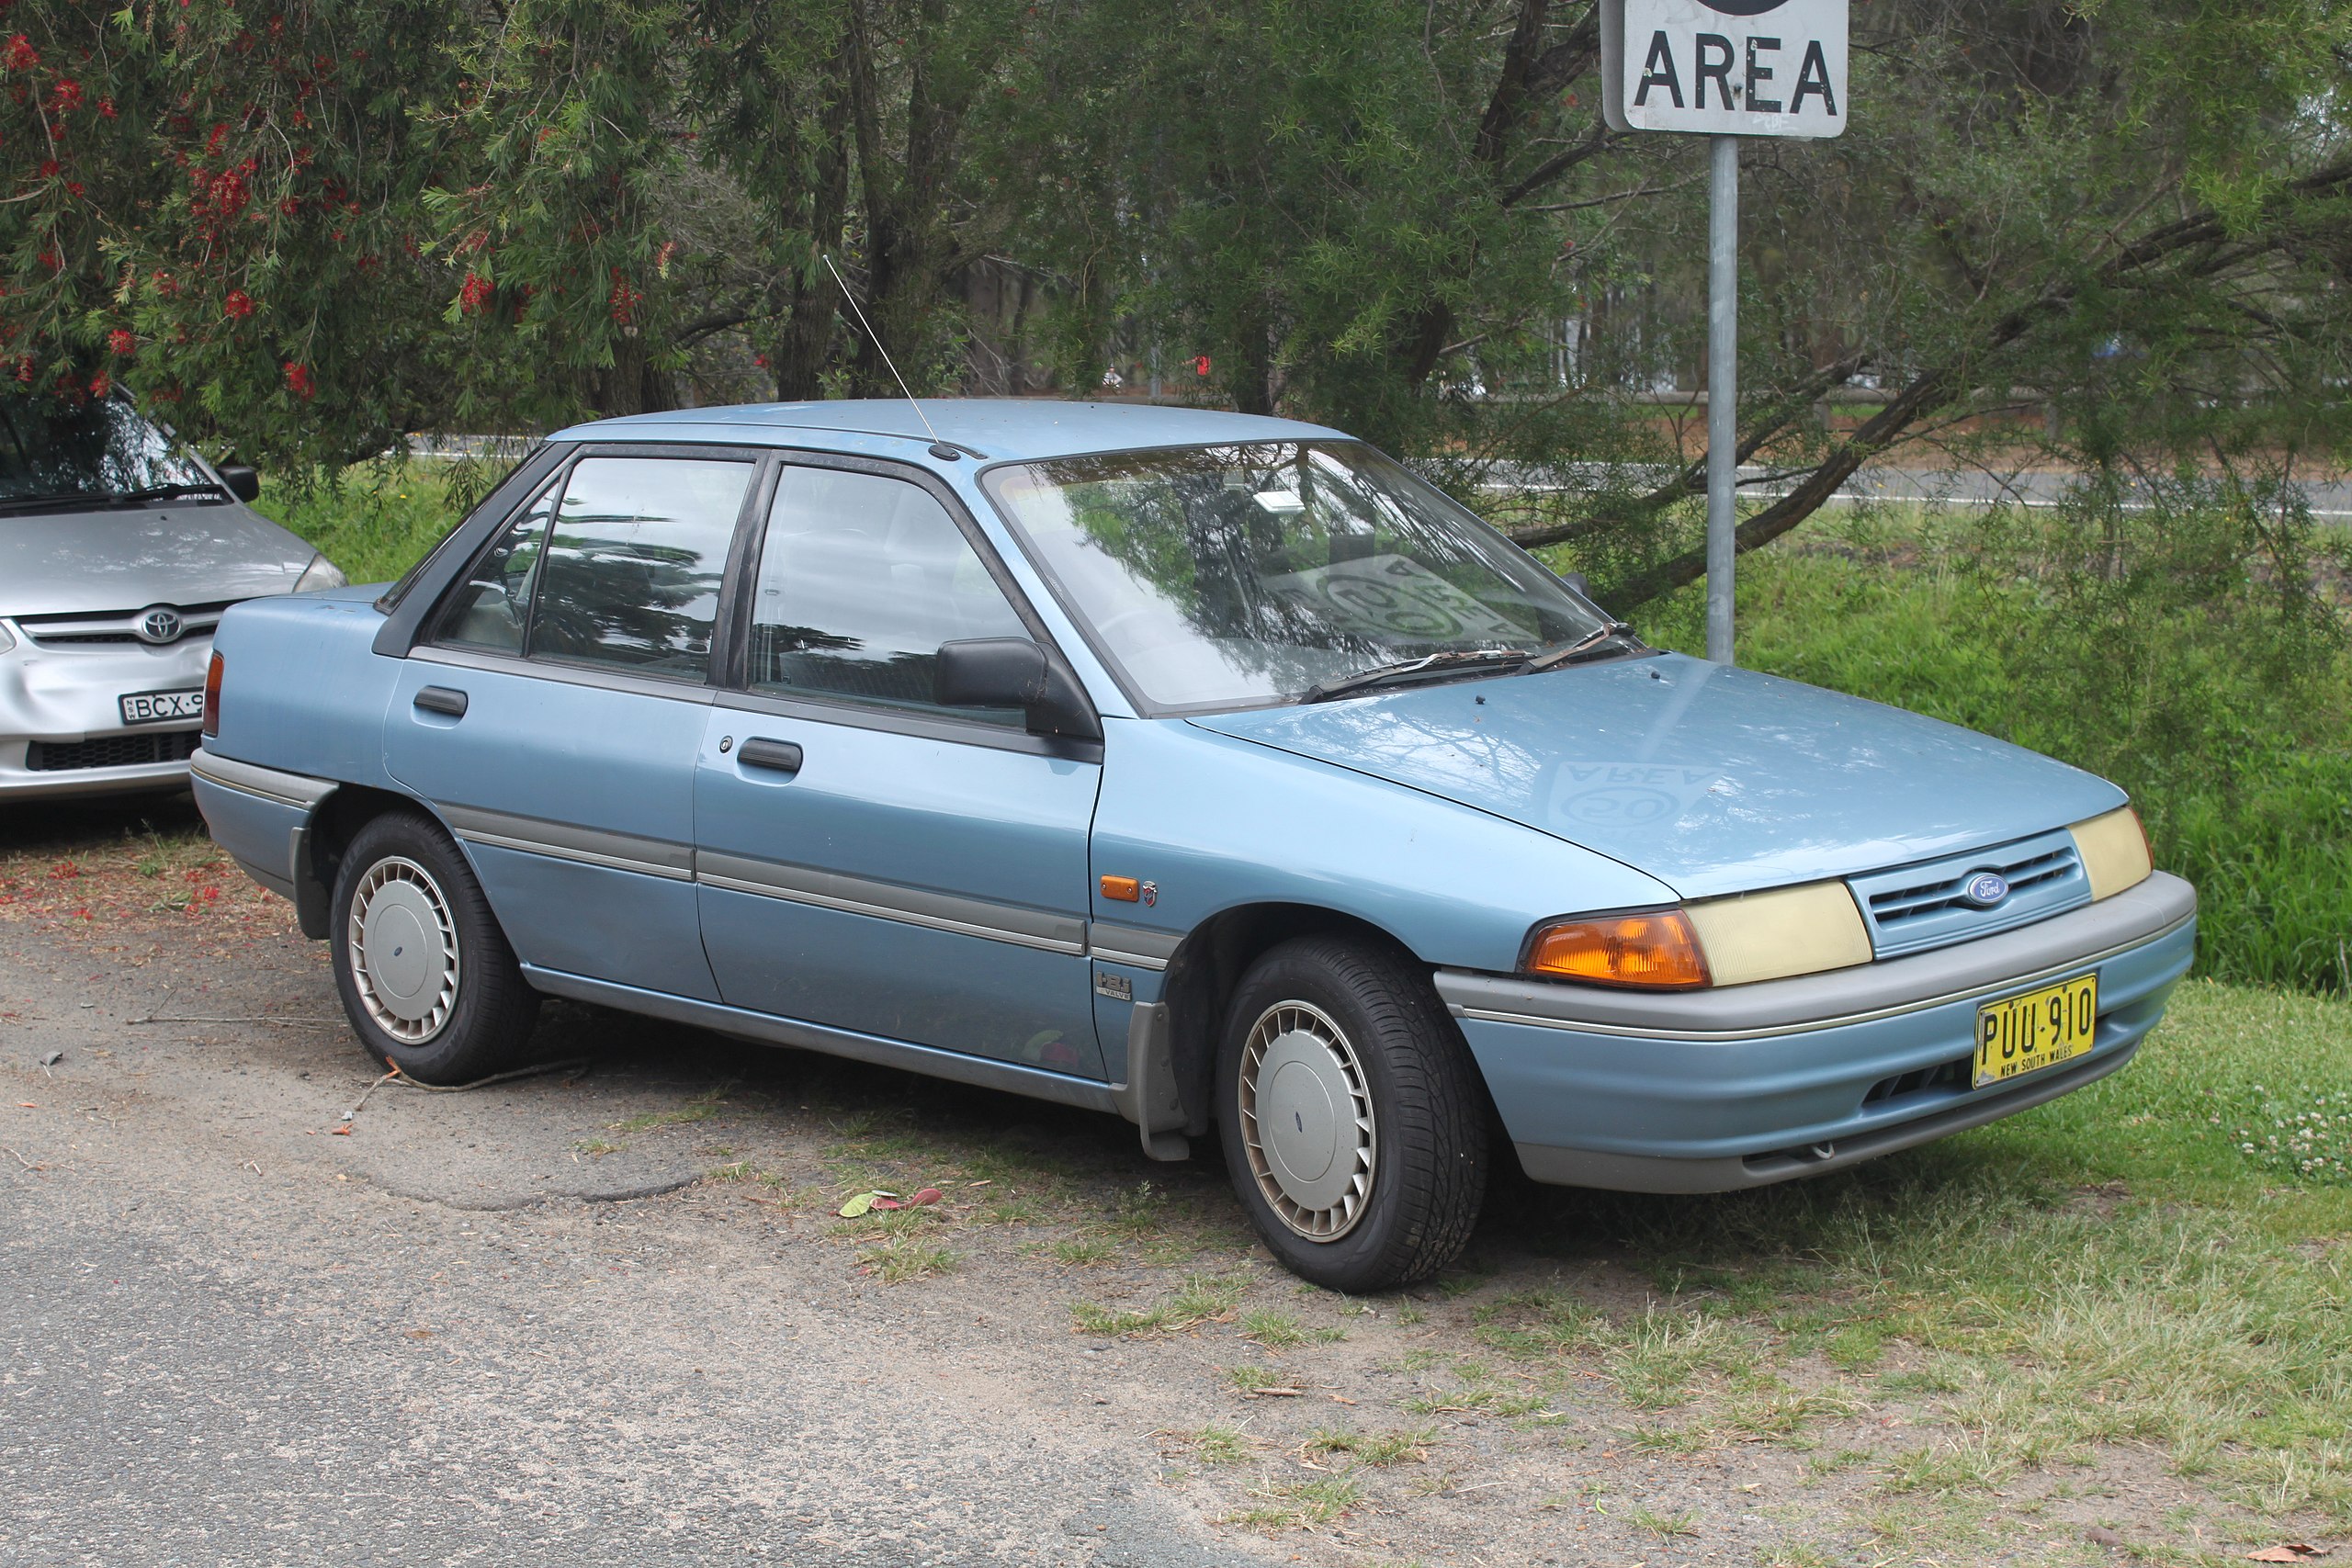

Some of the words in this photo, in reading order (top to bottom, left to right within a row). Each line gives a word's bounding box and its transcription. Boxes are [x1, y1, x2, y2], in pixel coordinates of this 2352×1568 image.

[1634, 30, 1838, 116] AREA
[126, 700, 136, 719] NSW
[1979, 880, 2000, 897] Ford
[2000, 1062, 2018, 1077] NEW
[2021, 1054, 2045, 1070] SOUTH
[2050, 1044, 2073, 1062] WALES
